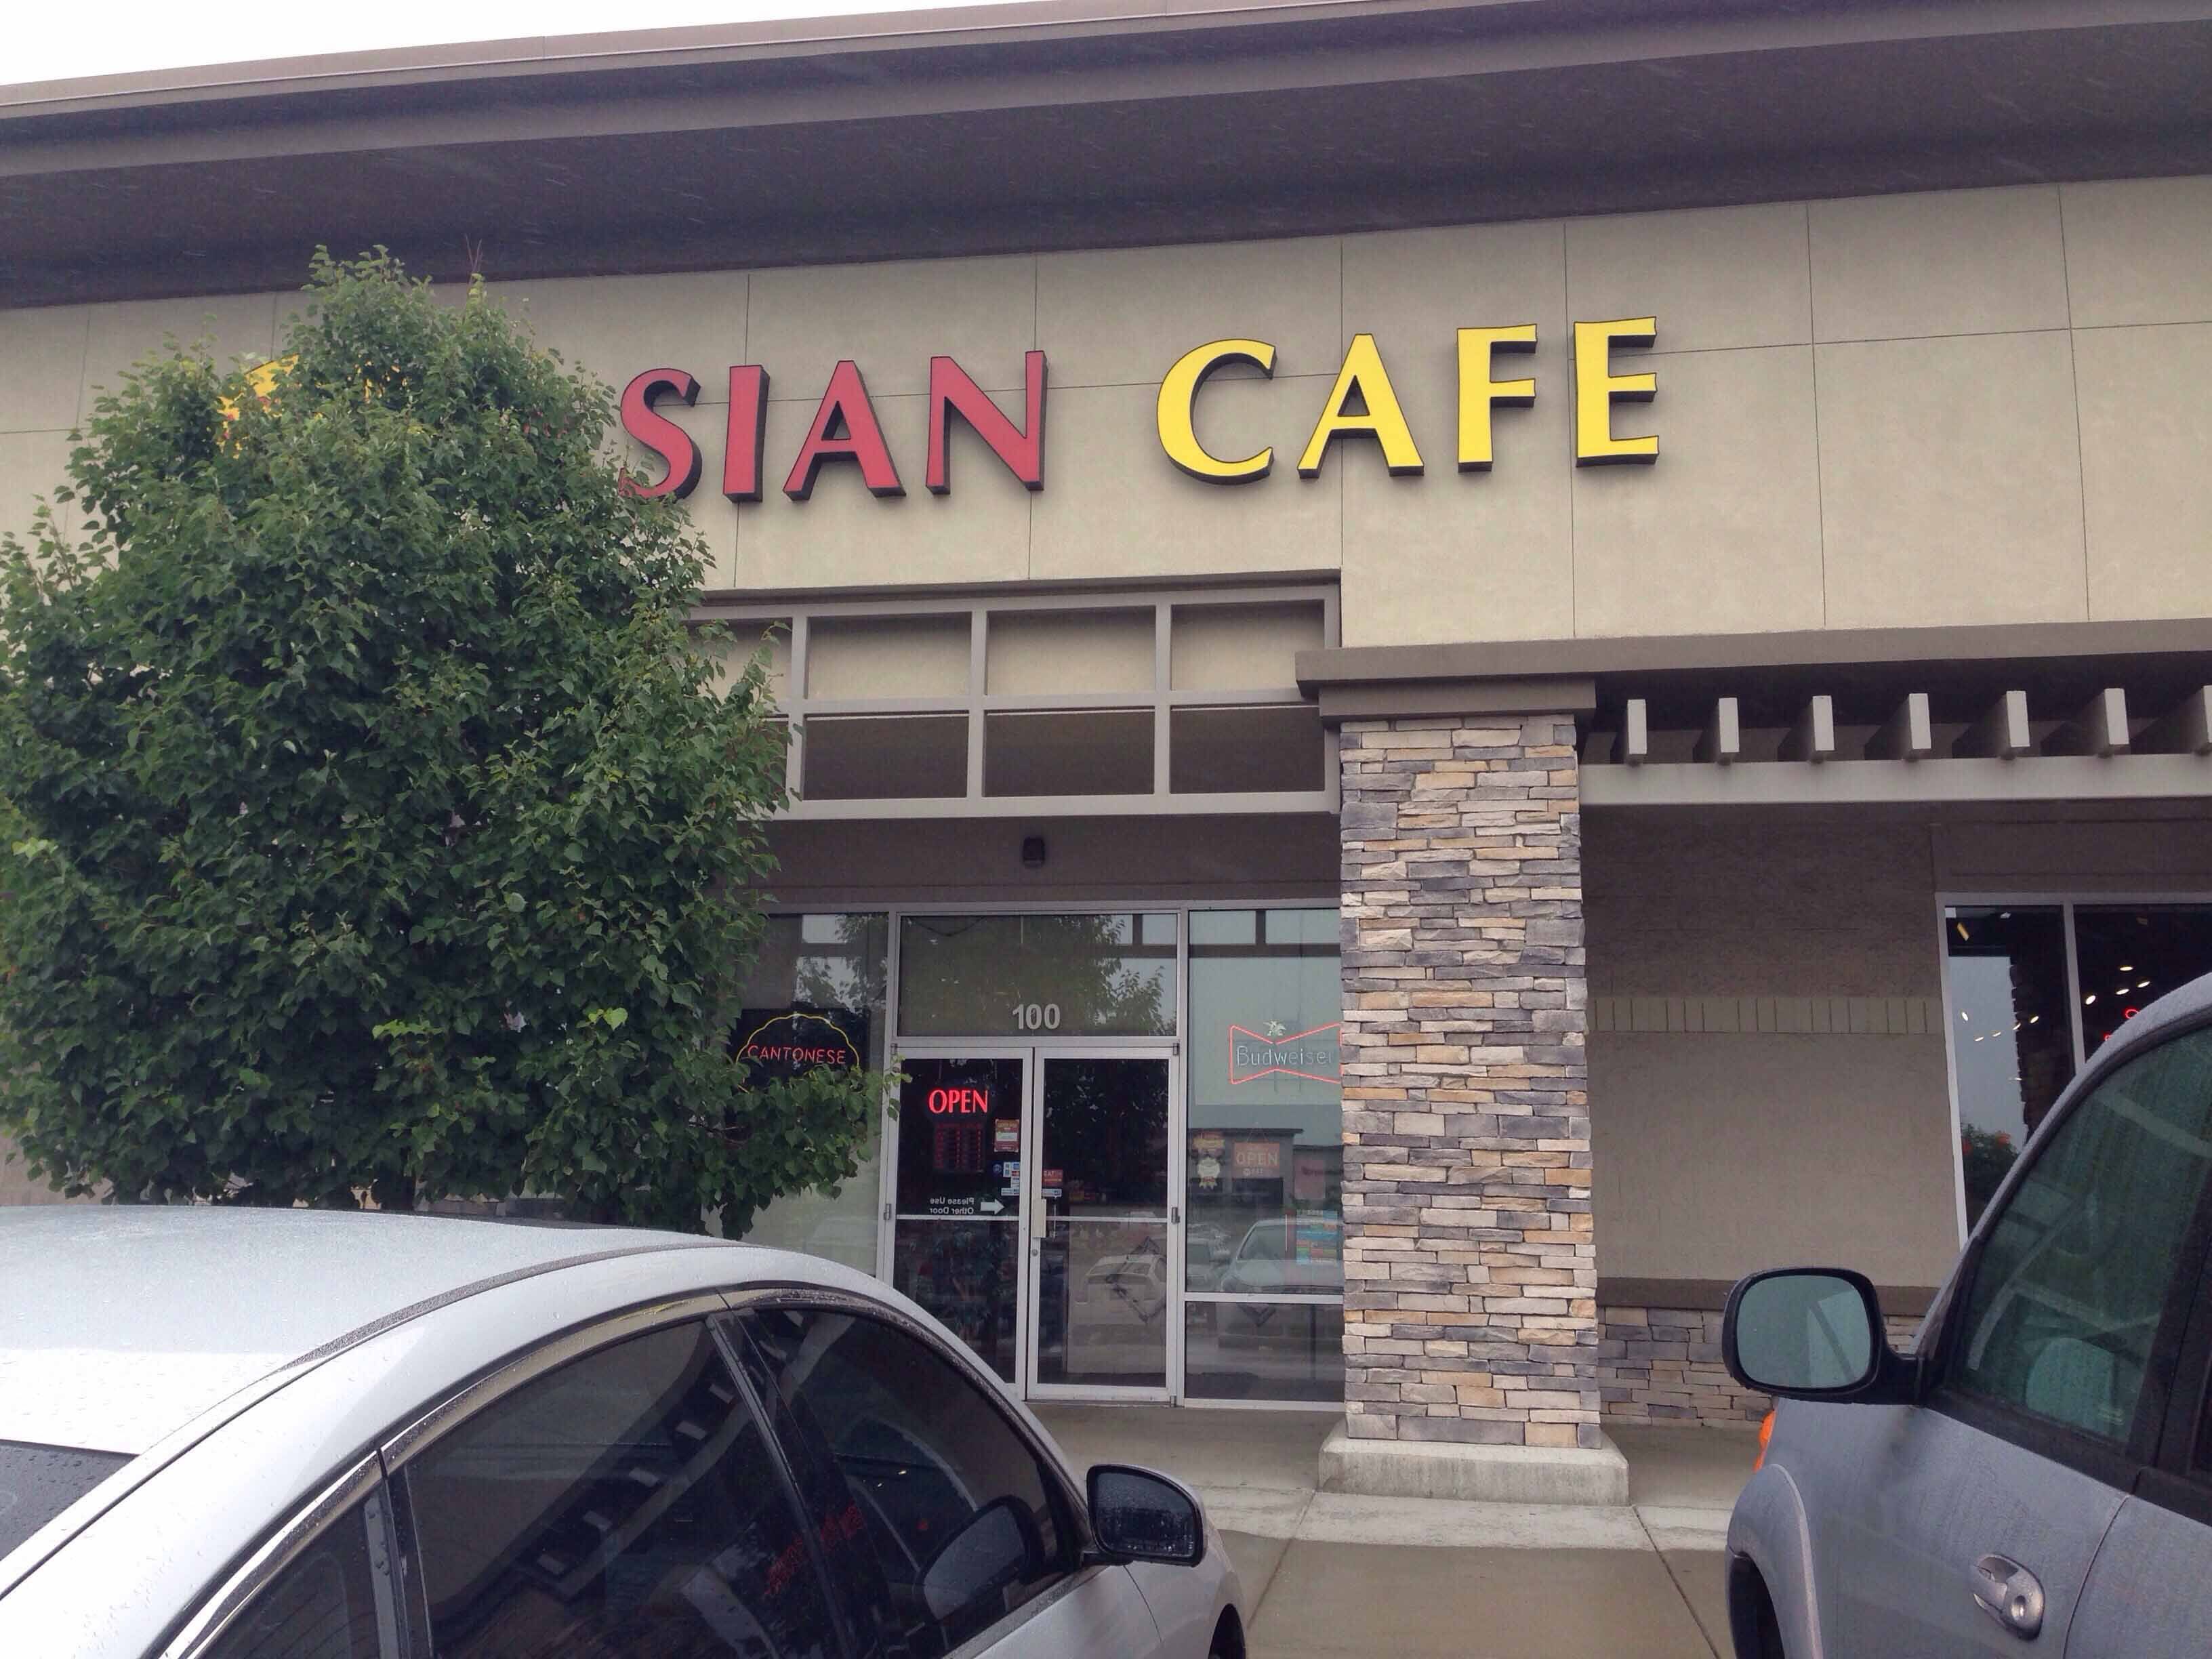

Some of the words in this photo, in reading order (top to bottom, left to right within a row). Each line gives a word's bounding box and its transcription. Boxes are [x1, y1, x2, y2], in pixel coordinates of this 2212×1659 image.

[619, 350, 1049, 501] SIAN
[1157, 316, 1659, 485] CAFE
[1012, 1004, 1061, 1030] 100
[747, 1045, 846, 1064] CANTONESE
[1236, 1045, 1332, 1066] Budweiser
[928, 1089, 989, 1113] OPEN
[1236, 1151, 1278, 1166] OPEN
